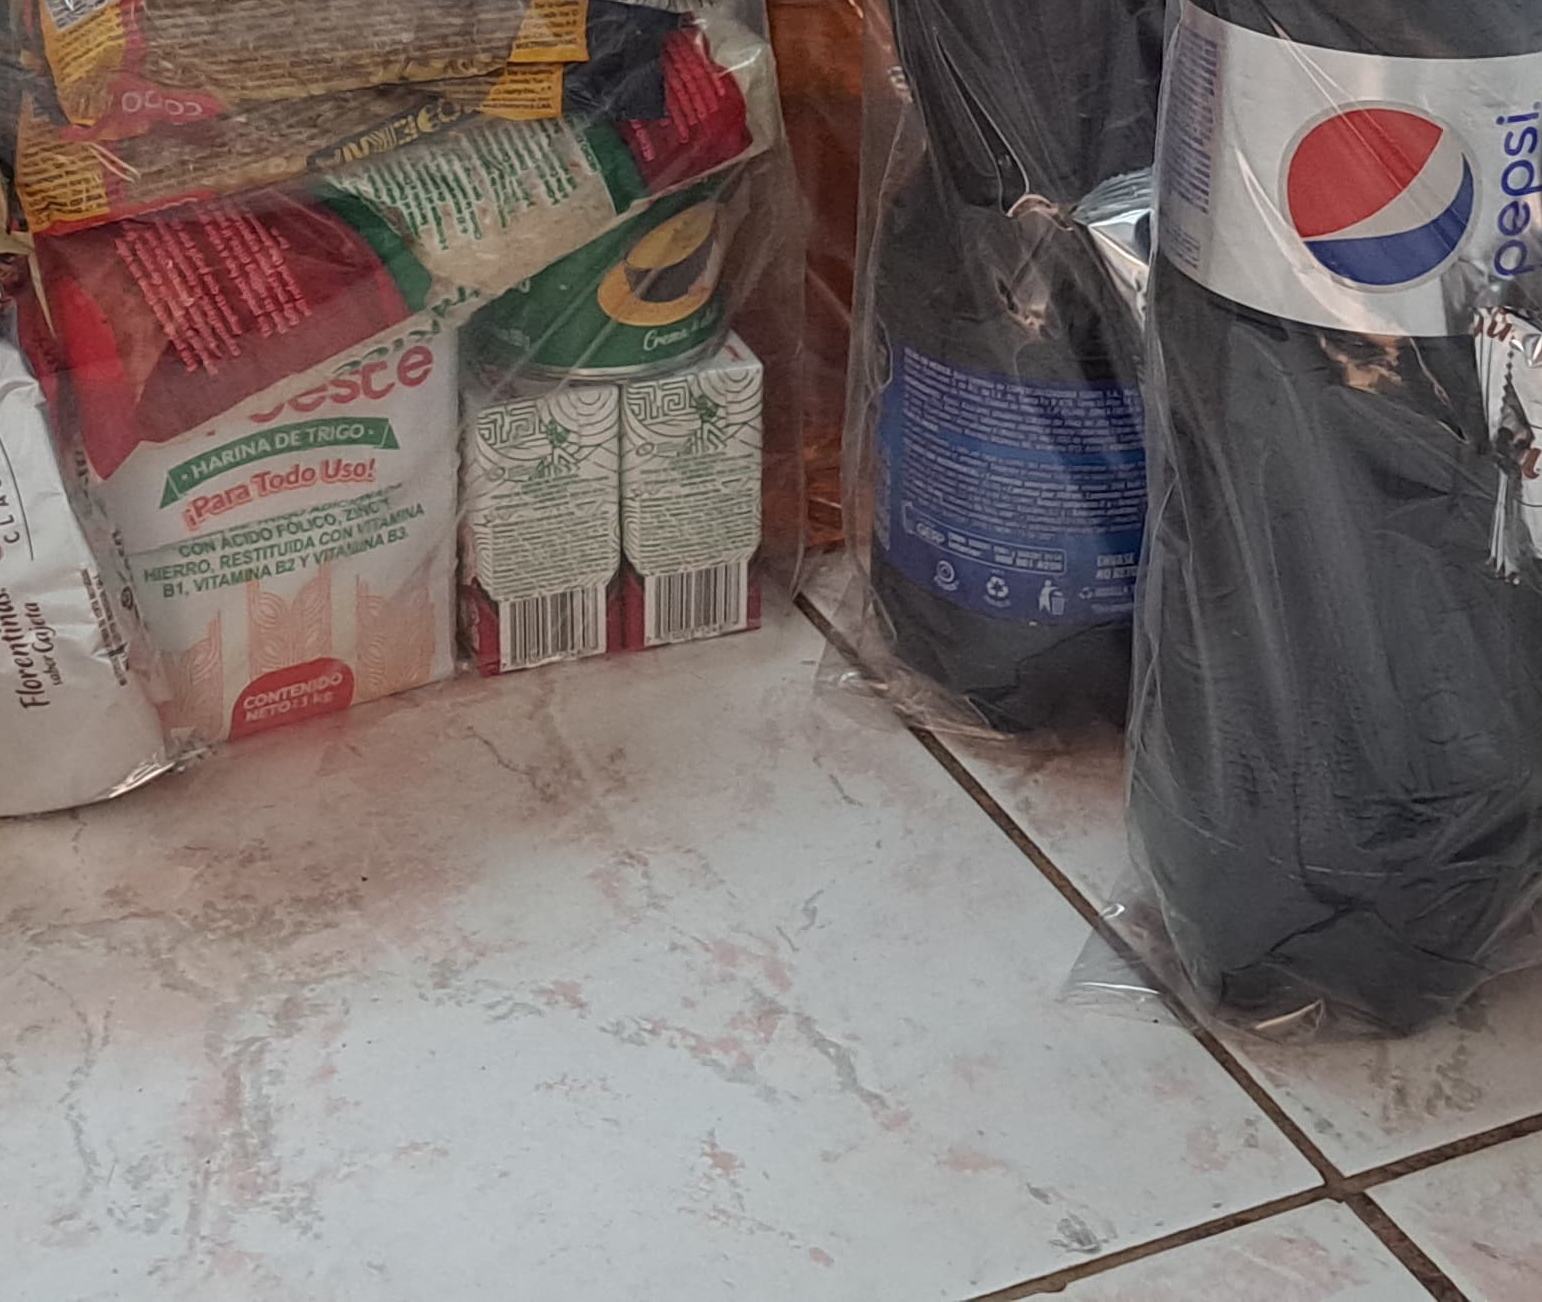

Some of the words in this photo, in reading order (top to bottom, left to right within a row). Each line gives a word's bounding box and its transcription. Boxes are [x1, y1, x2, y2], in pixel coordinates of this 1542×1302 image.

[1492, 109, 1542, 279] pepsi
[188, 437, 270, 477] HARINA
[273, 431, 301, 453] DE
[304, 422, 366, 446] TRIGO
[182, 484, 253, 532] ¡Para
[256, 463, 318, 496] Todo
[319, 457, 377, 485] Uso!
[143, 557, 217, 583] HIERRO,
[220, 532, 317, 572] RESTITUIDA
[319, 525, 356, 551] CON
[162, 582, 192, 600] B1,
[194, 562, 273, 594] VITAMINA
[274, 557, 298, 576] B2
[298, 553, 311, 570] Y
[177, 539, 217, 560] CON
[23, 600, 59, 654] Cajeta
[241, 670, 344, 711] CONTENIDO
